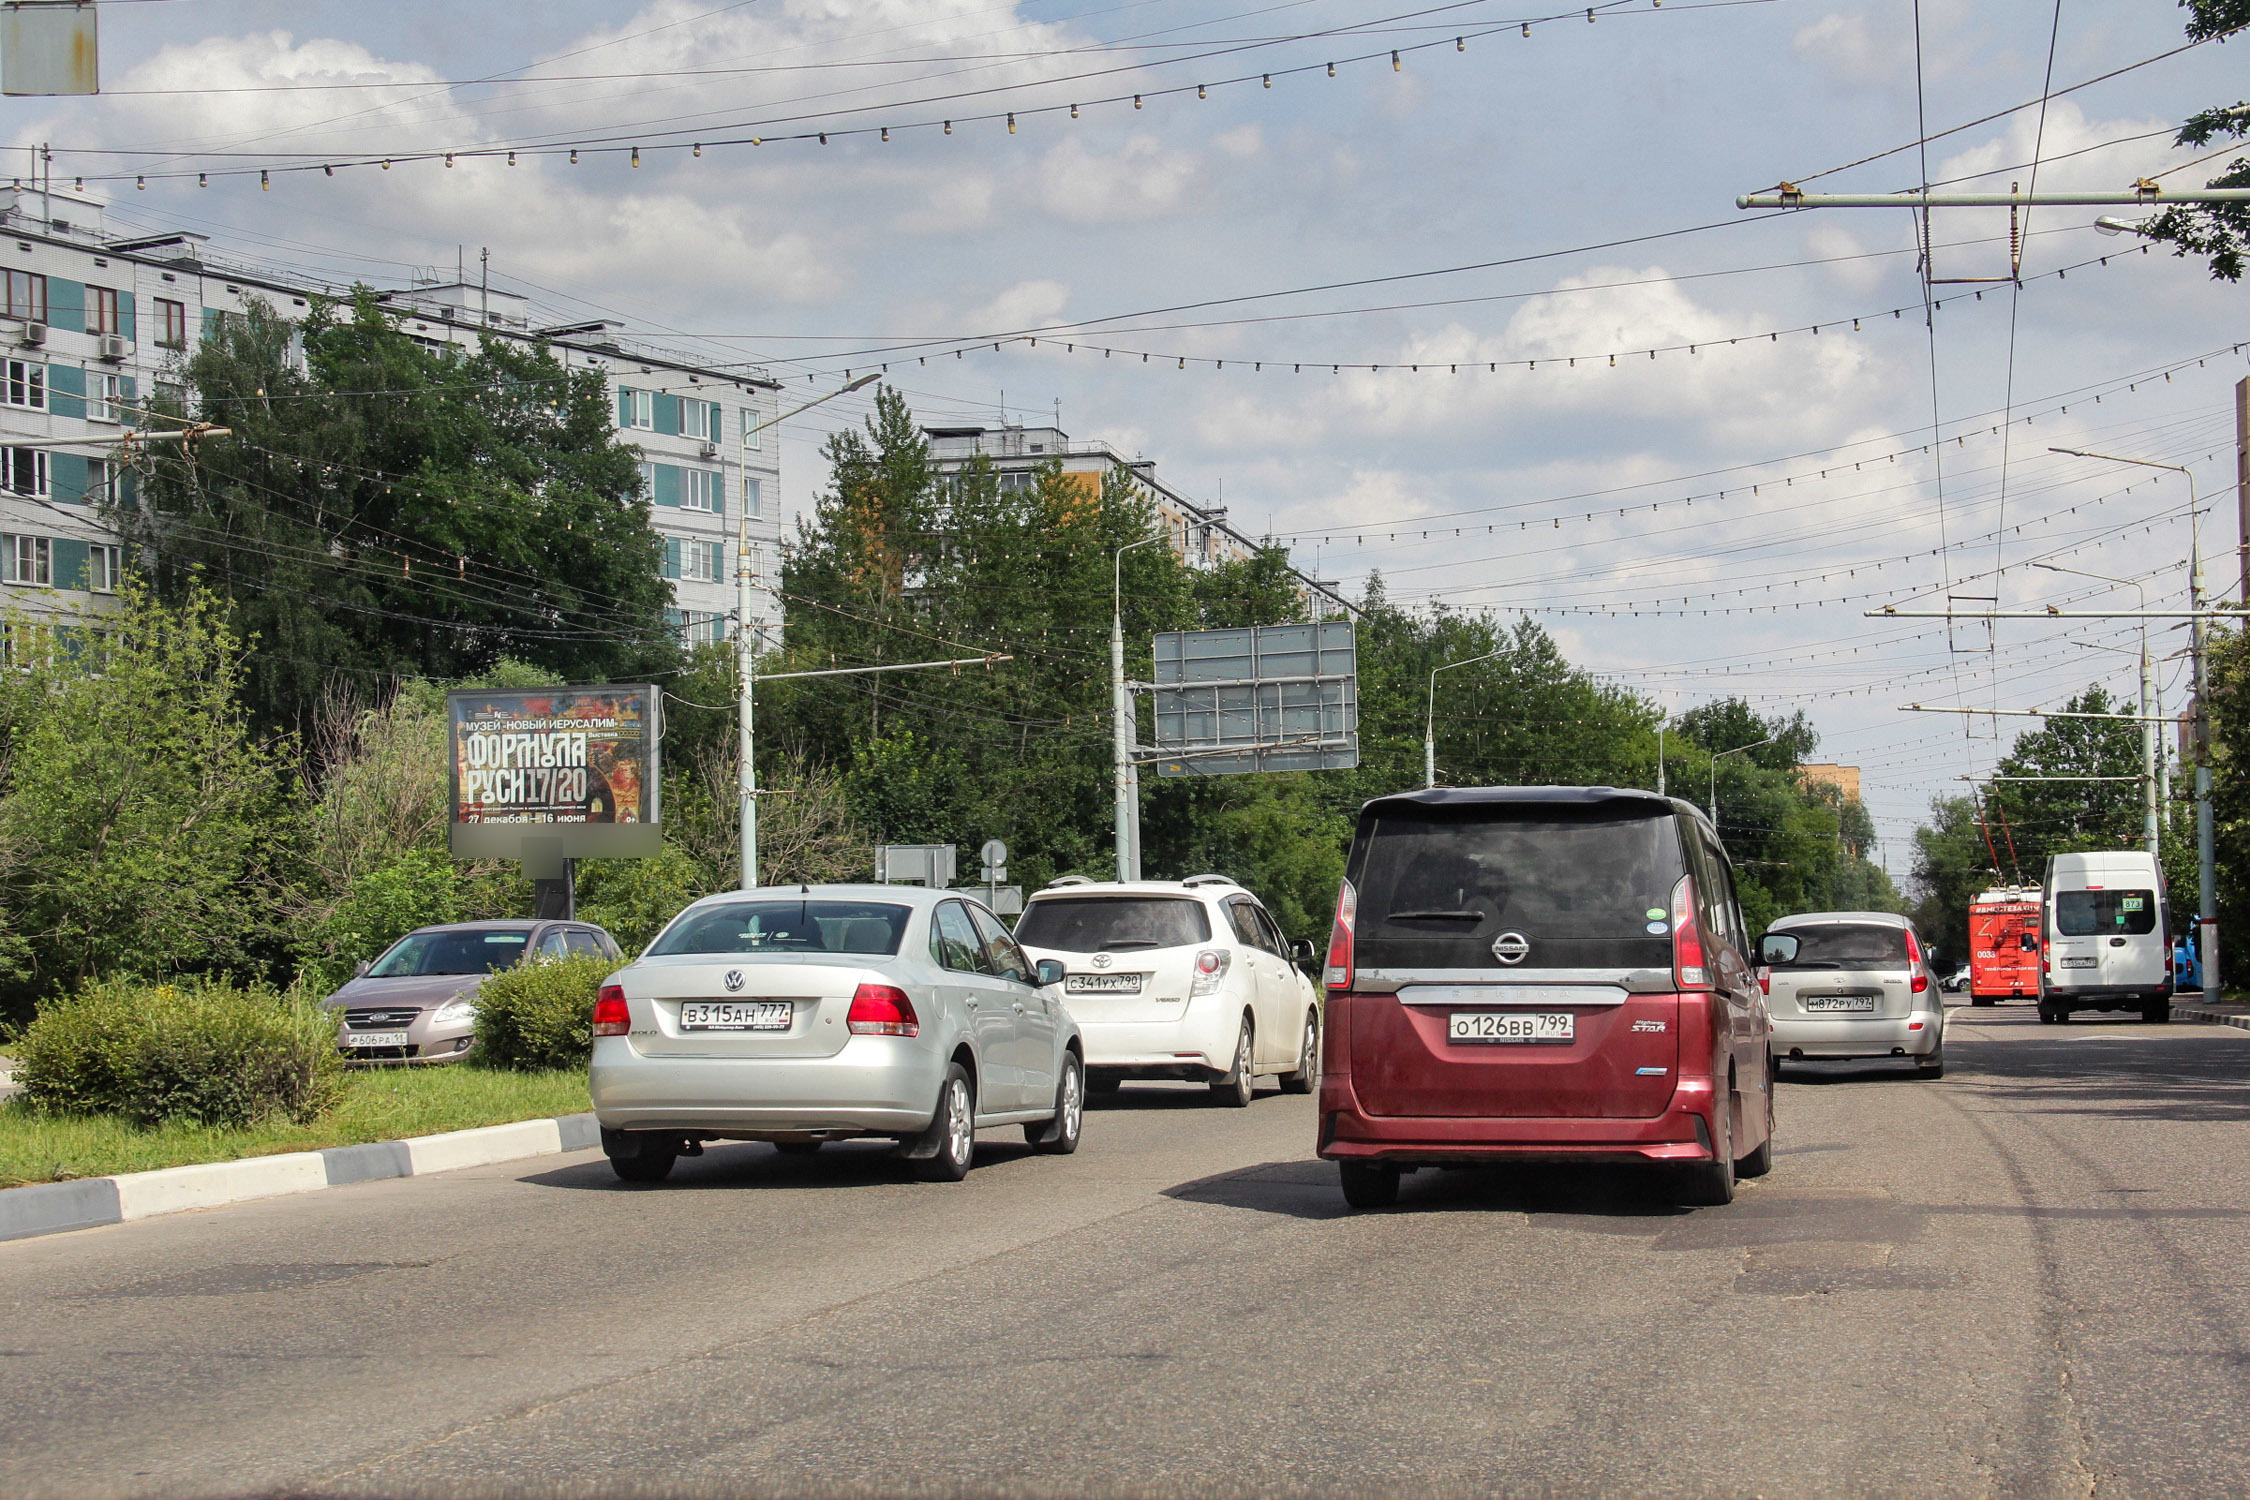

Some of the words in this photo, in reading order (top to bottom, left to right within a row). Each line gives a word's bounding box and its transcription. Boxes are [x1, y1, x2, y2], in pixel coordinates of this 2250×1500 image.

[466, 719, 500, 731] МУЗЕЙ
[467, 732, 587, 769] ФОРМУЛА
[468, 814, 480, 823] 27
[483, 813, 528, 823] декабря
[543, 813, 554, 823] 16
[557, 814, 586, 823] июня
[1452, 990, 1571, 998] SERENA
